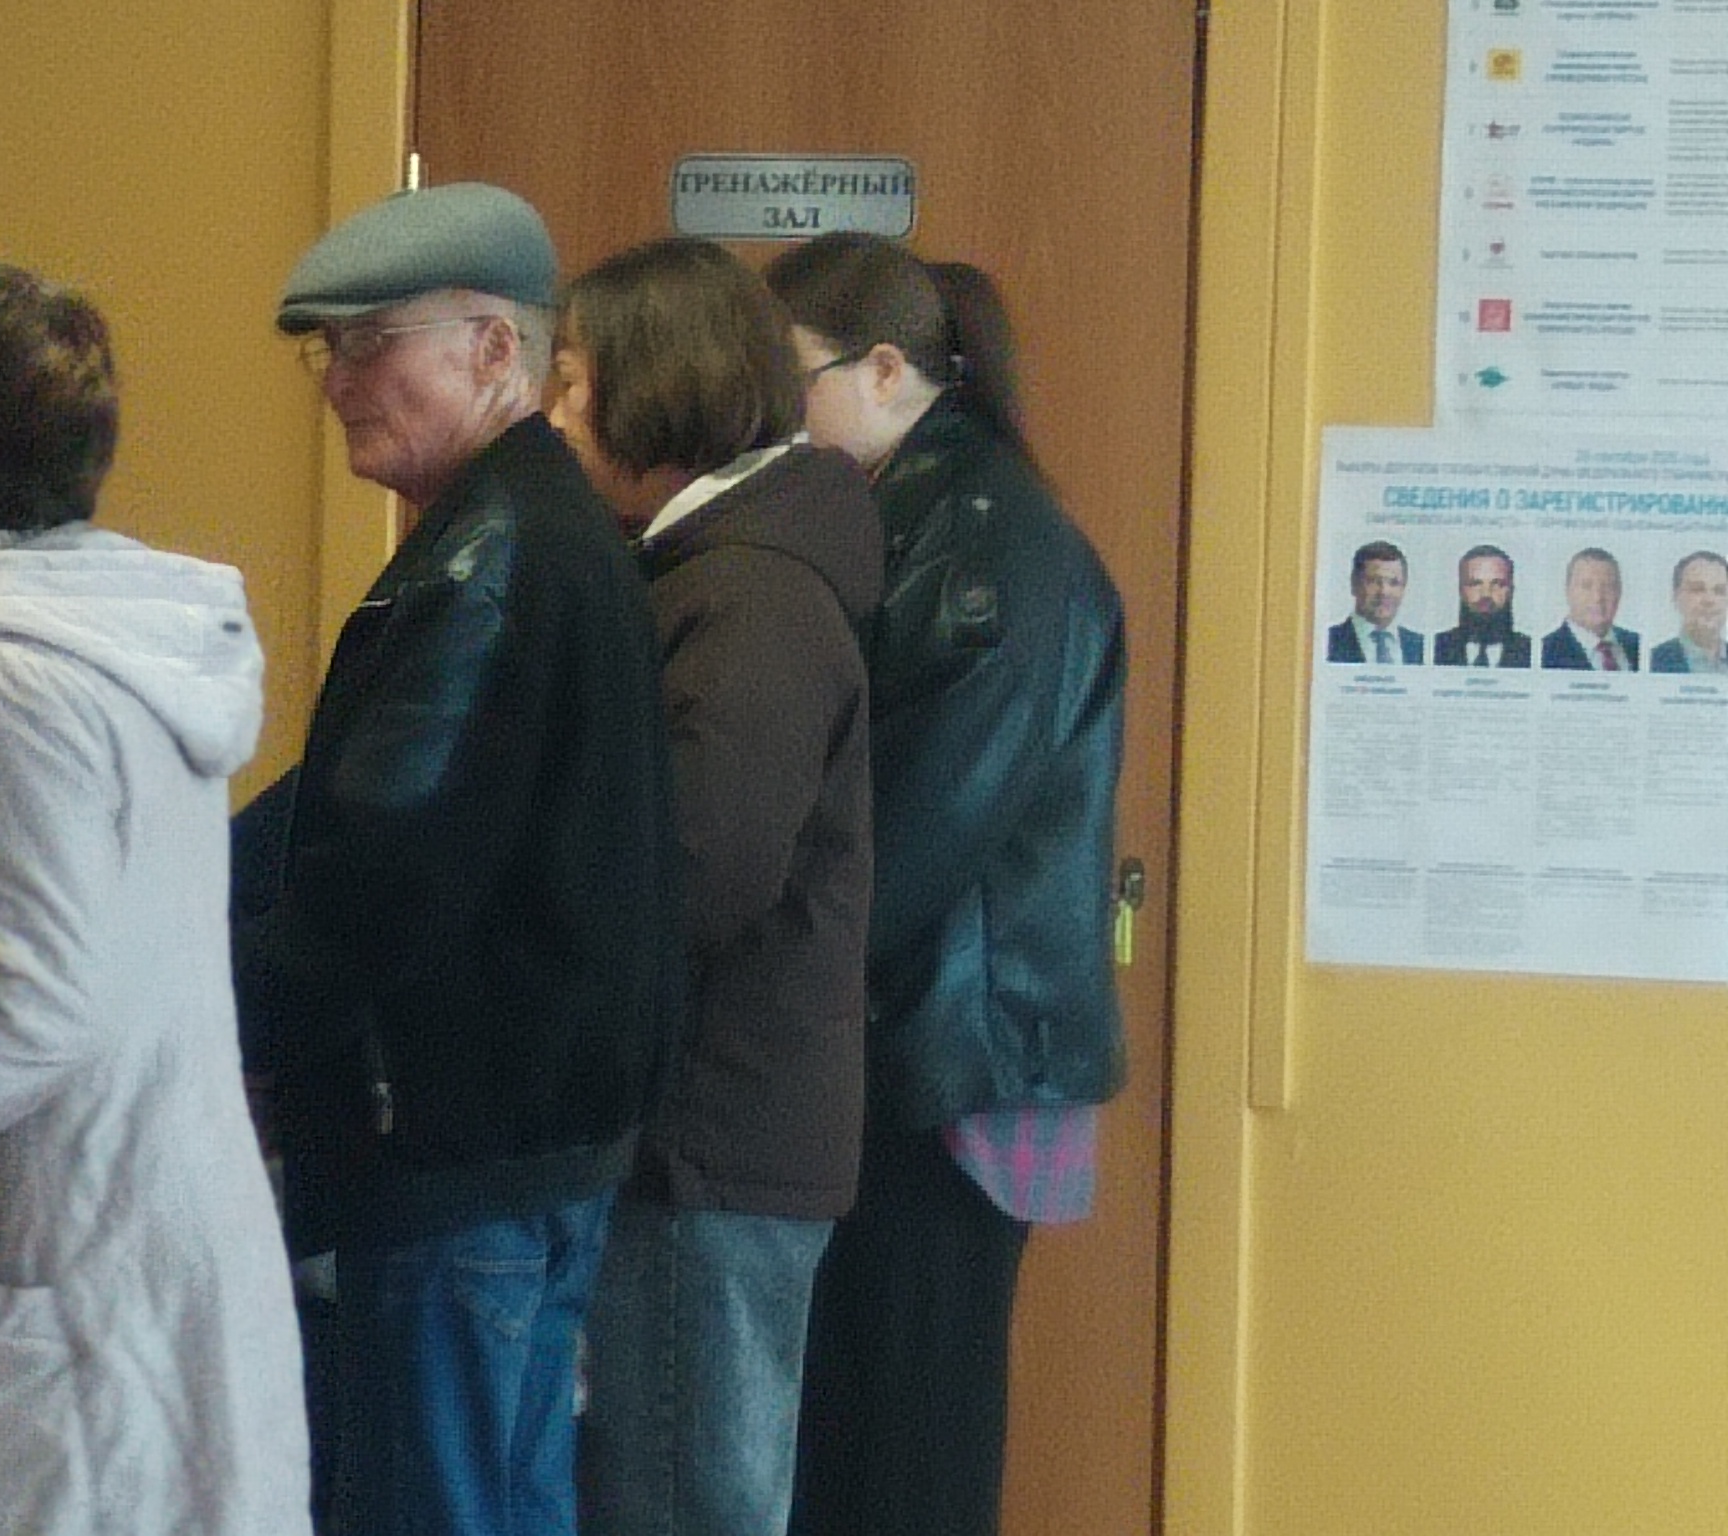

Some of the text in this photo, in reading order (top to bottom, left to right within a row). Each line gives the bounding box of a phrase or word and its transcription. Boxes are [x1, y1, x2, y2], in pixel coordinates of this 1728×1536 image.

[677, 169, 913, 195] ТРЕНАЖЁРНЫЙ
[762, 206, 821, 229] ЗАЛ
[1383, 485, 1490, 510] СВЕДЕНИЯ
[1495, 487, 1511, 510] О
